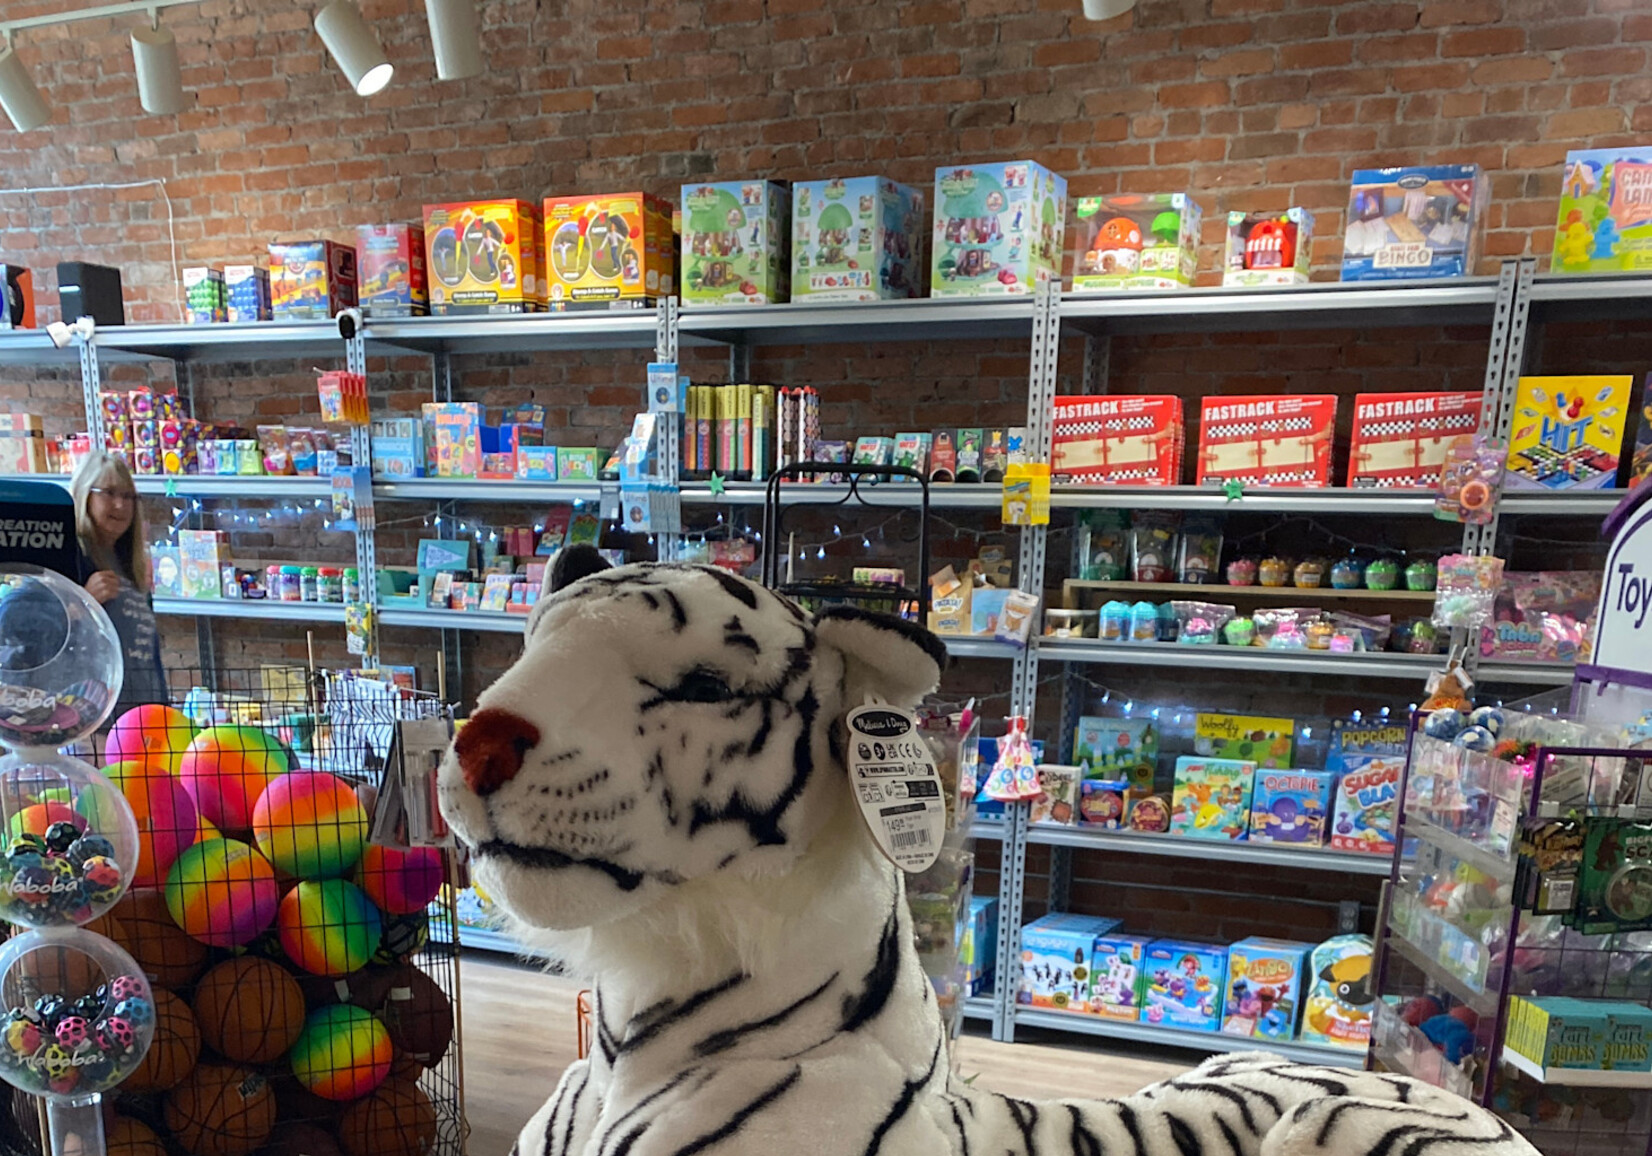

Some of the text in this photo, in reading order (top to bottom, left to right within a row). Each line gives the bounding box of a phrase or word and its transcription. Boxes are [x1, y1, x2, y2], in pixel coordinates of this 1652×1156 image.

[1378, 249, 1430, 266] BINGO
[1205, 400, 1275, 421] FASTRACK
[1358, 397, 1435, 420] FASTRACK
[1539, 415, 1595, 455] HIT
[1201, 716, 1239, 738] Woolfy
[1342, 727, 1406, 747] POPCORN
